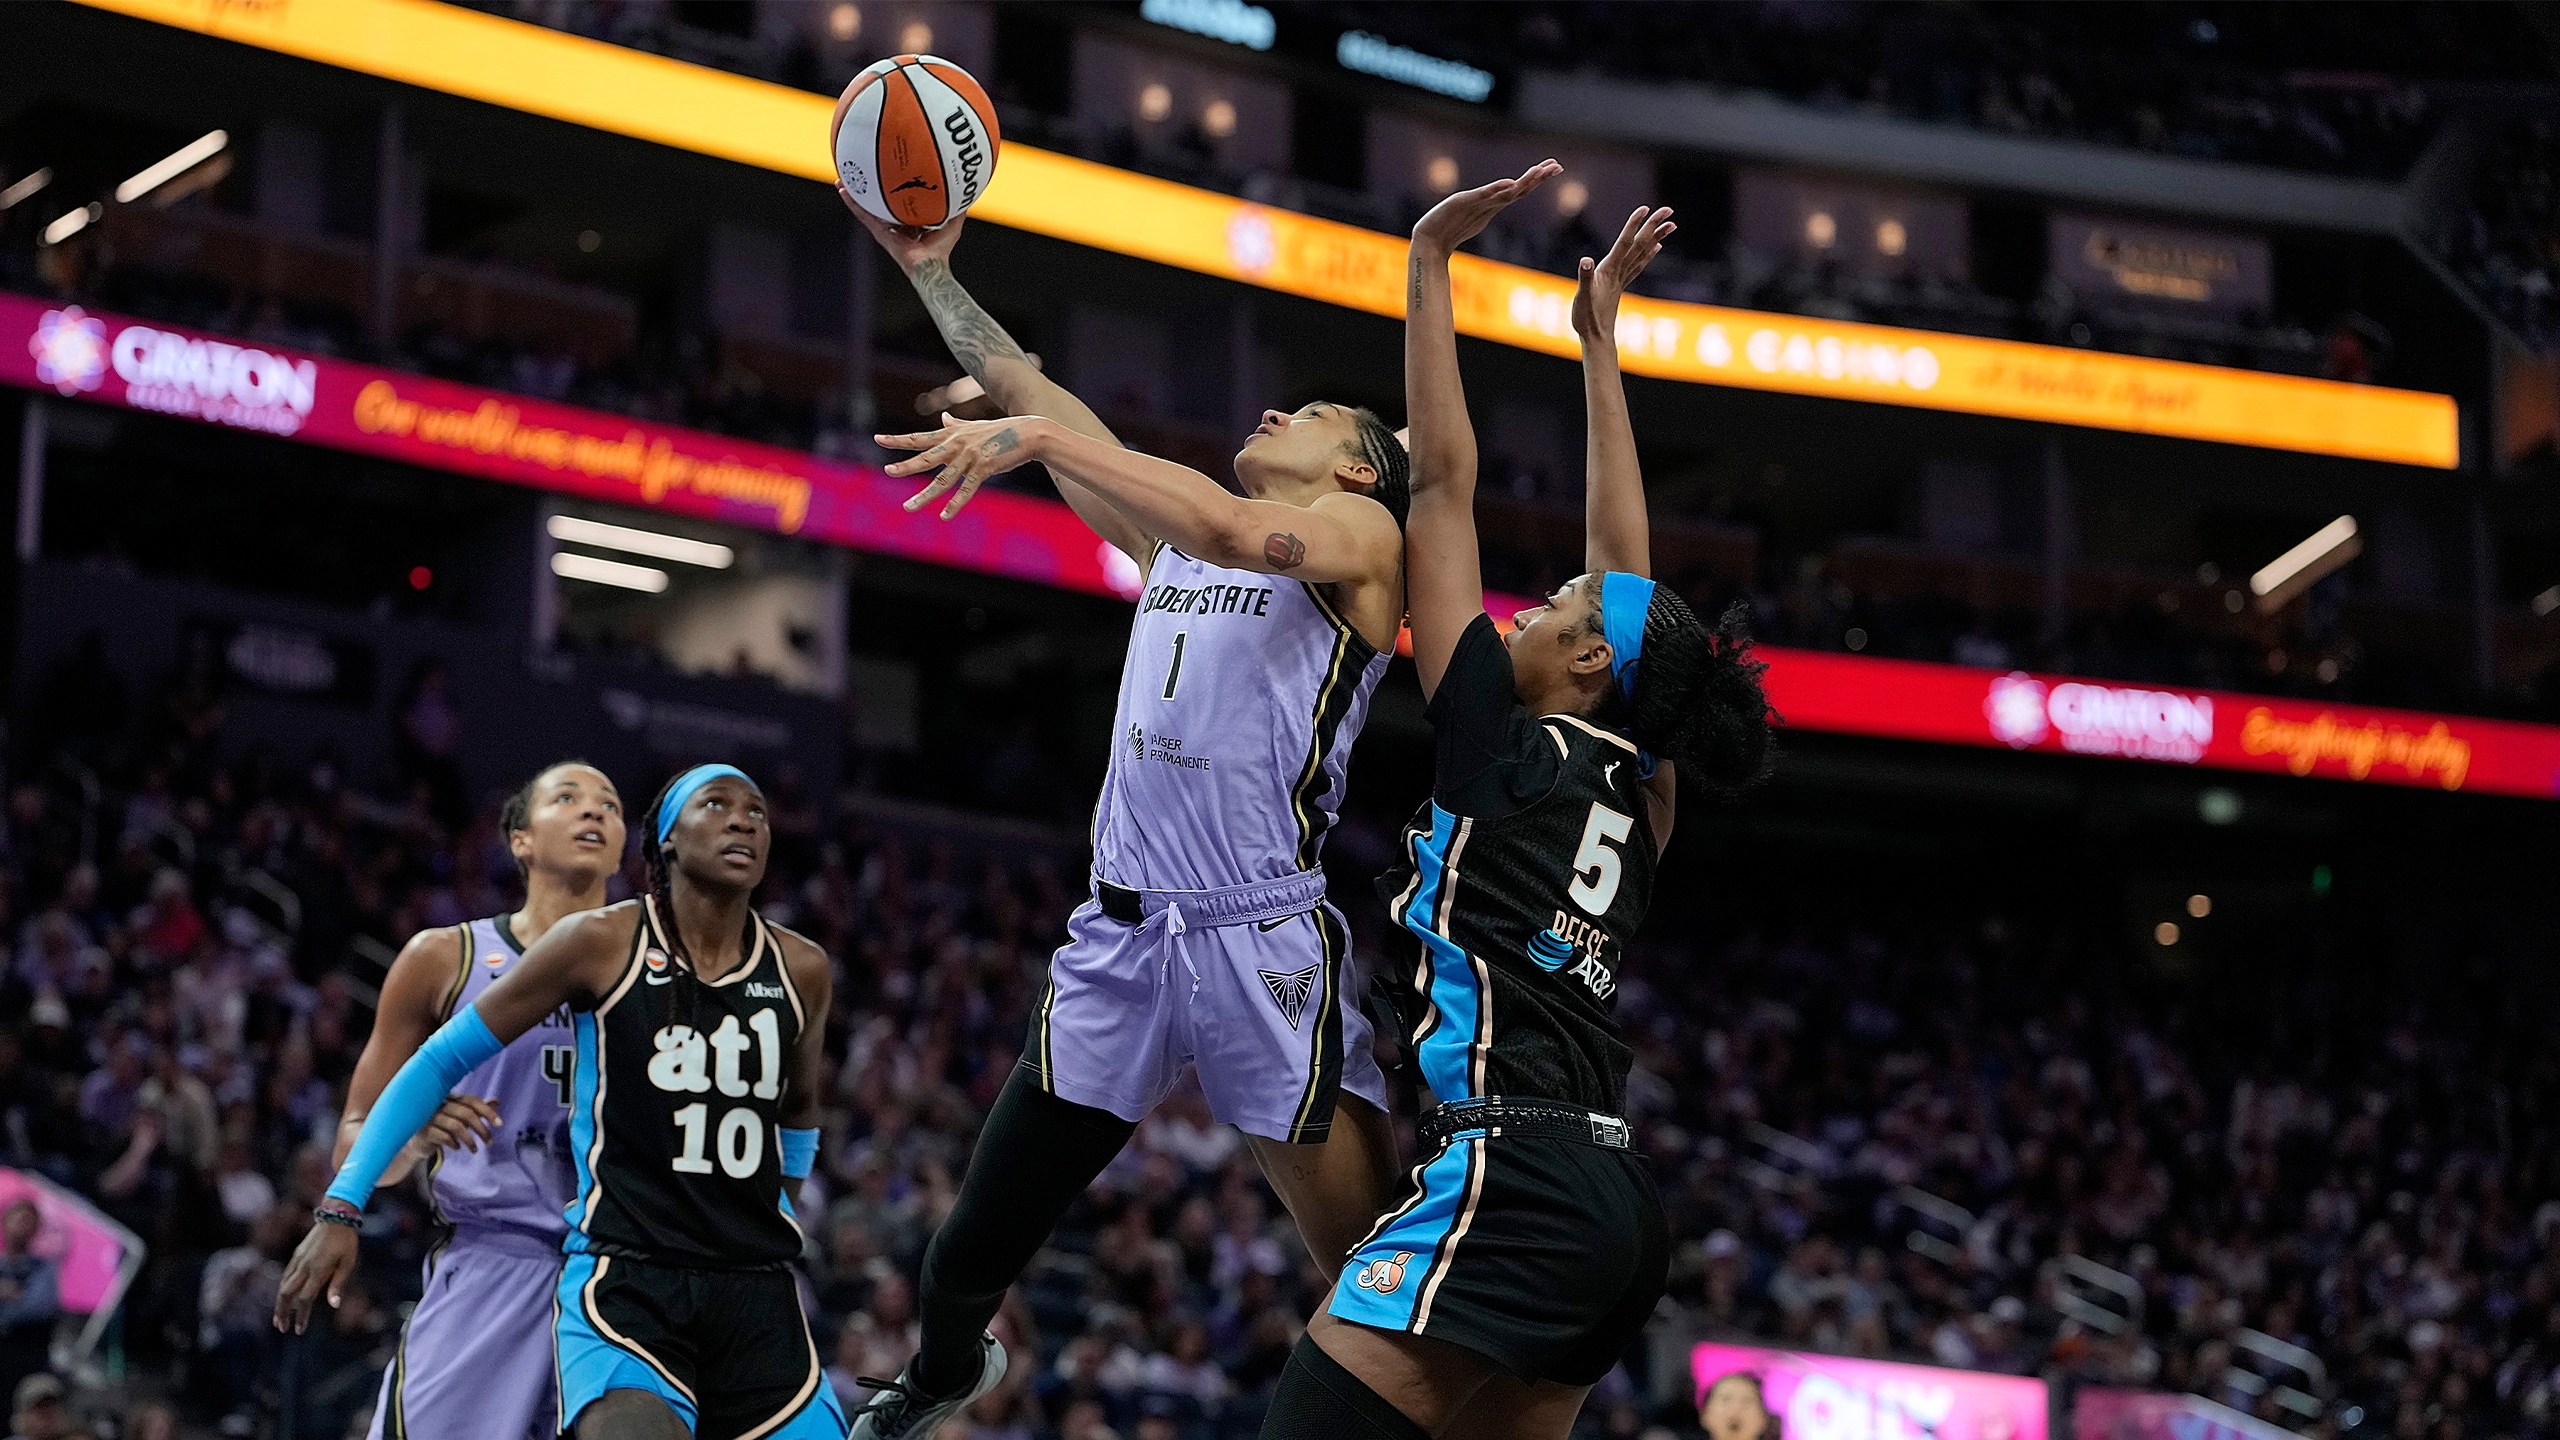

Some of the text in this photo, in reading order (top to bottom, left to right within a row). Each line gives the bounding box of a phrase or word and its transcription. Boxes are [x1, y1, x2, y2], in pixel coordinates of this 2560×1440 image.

[945, 106, 984, 212] Wilson
[1197, 583, 1274, 618] STATE
[1161, 630, 1187, 702] 1
[1567, 800, 1635, 917] 5
[1552, 909, 1610, 959] REESE
[647, 1007, 781, 1101] atl
[672, 1102, 764, 1180] 10
